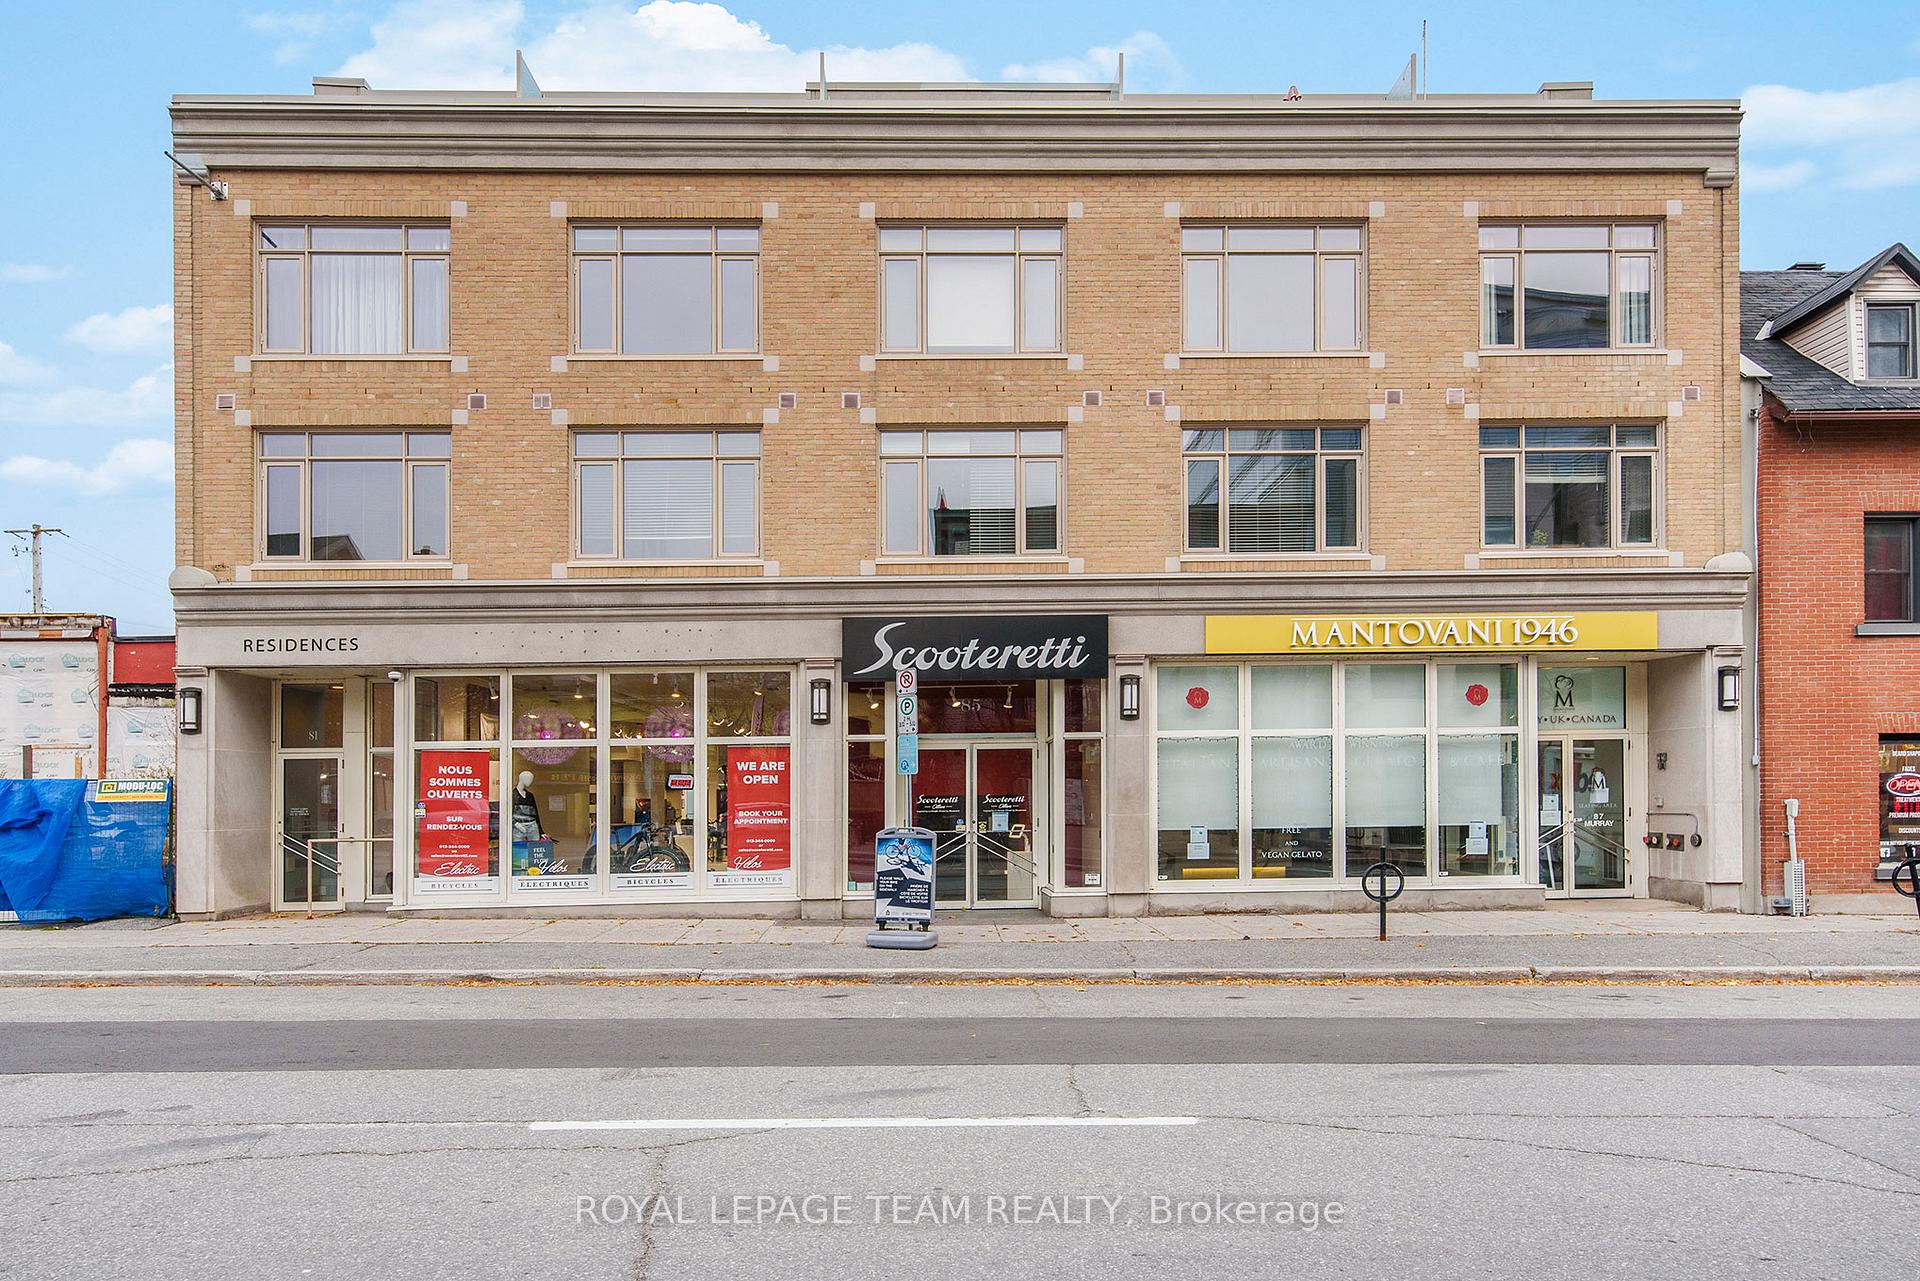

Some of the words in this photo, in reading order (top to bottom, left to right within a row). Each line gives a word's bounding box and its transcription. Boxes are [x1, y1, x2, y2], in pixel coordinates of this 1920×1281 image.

[1290, 619, 1503, 647] MANTOVANI
[1512, 618, 1579, 645] 1946
[243, 638, 359, 652] RESIDENCES
[853, 621, 1090, 675] Scooteretti
[1554, 690, 1574, 707] M
[961, 698, 981, 712] 85
[1571, 714, 1617, 723] CANADA
[1289, 739, 1327, 749] AWARD
[438, 765, 473, 775] NOUS
[736, 761, 757, 771] WE
[760, 761, 785, 771] ARE
[429, 777, 481, 787] SOMMES
[743, 775, 779, 785] OPEN
[118, 781, 164, 791] MODU-LOC
[427, 789, 483, 799] OUVERTS
[916, 793, 959, 804] Scooteretti
[982, 793, 1025, 804] Scooteretti
[446, 815, 463, 823] SUR
[427, 823, 482, 831] RENDEZ-VOUS
[1281, 826, 1301, 834] FREE
[1261, 851, 1289, 859] VEGAN
[1290, 850, 1322, 858] GELATO
[539, 859, 568, 875] Velos
[629, 857, 675, 872] Electric
[734, 855, 763, 869] Velos
[434, 861, 480, 876] Electric
